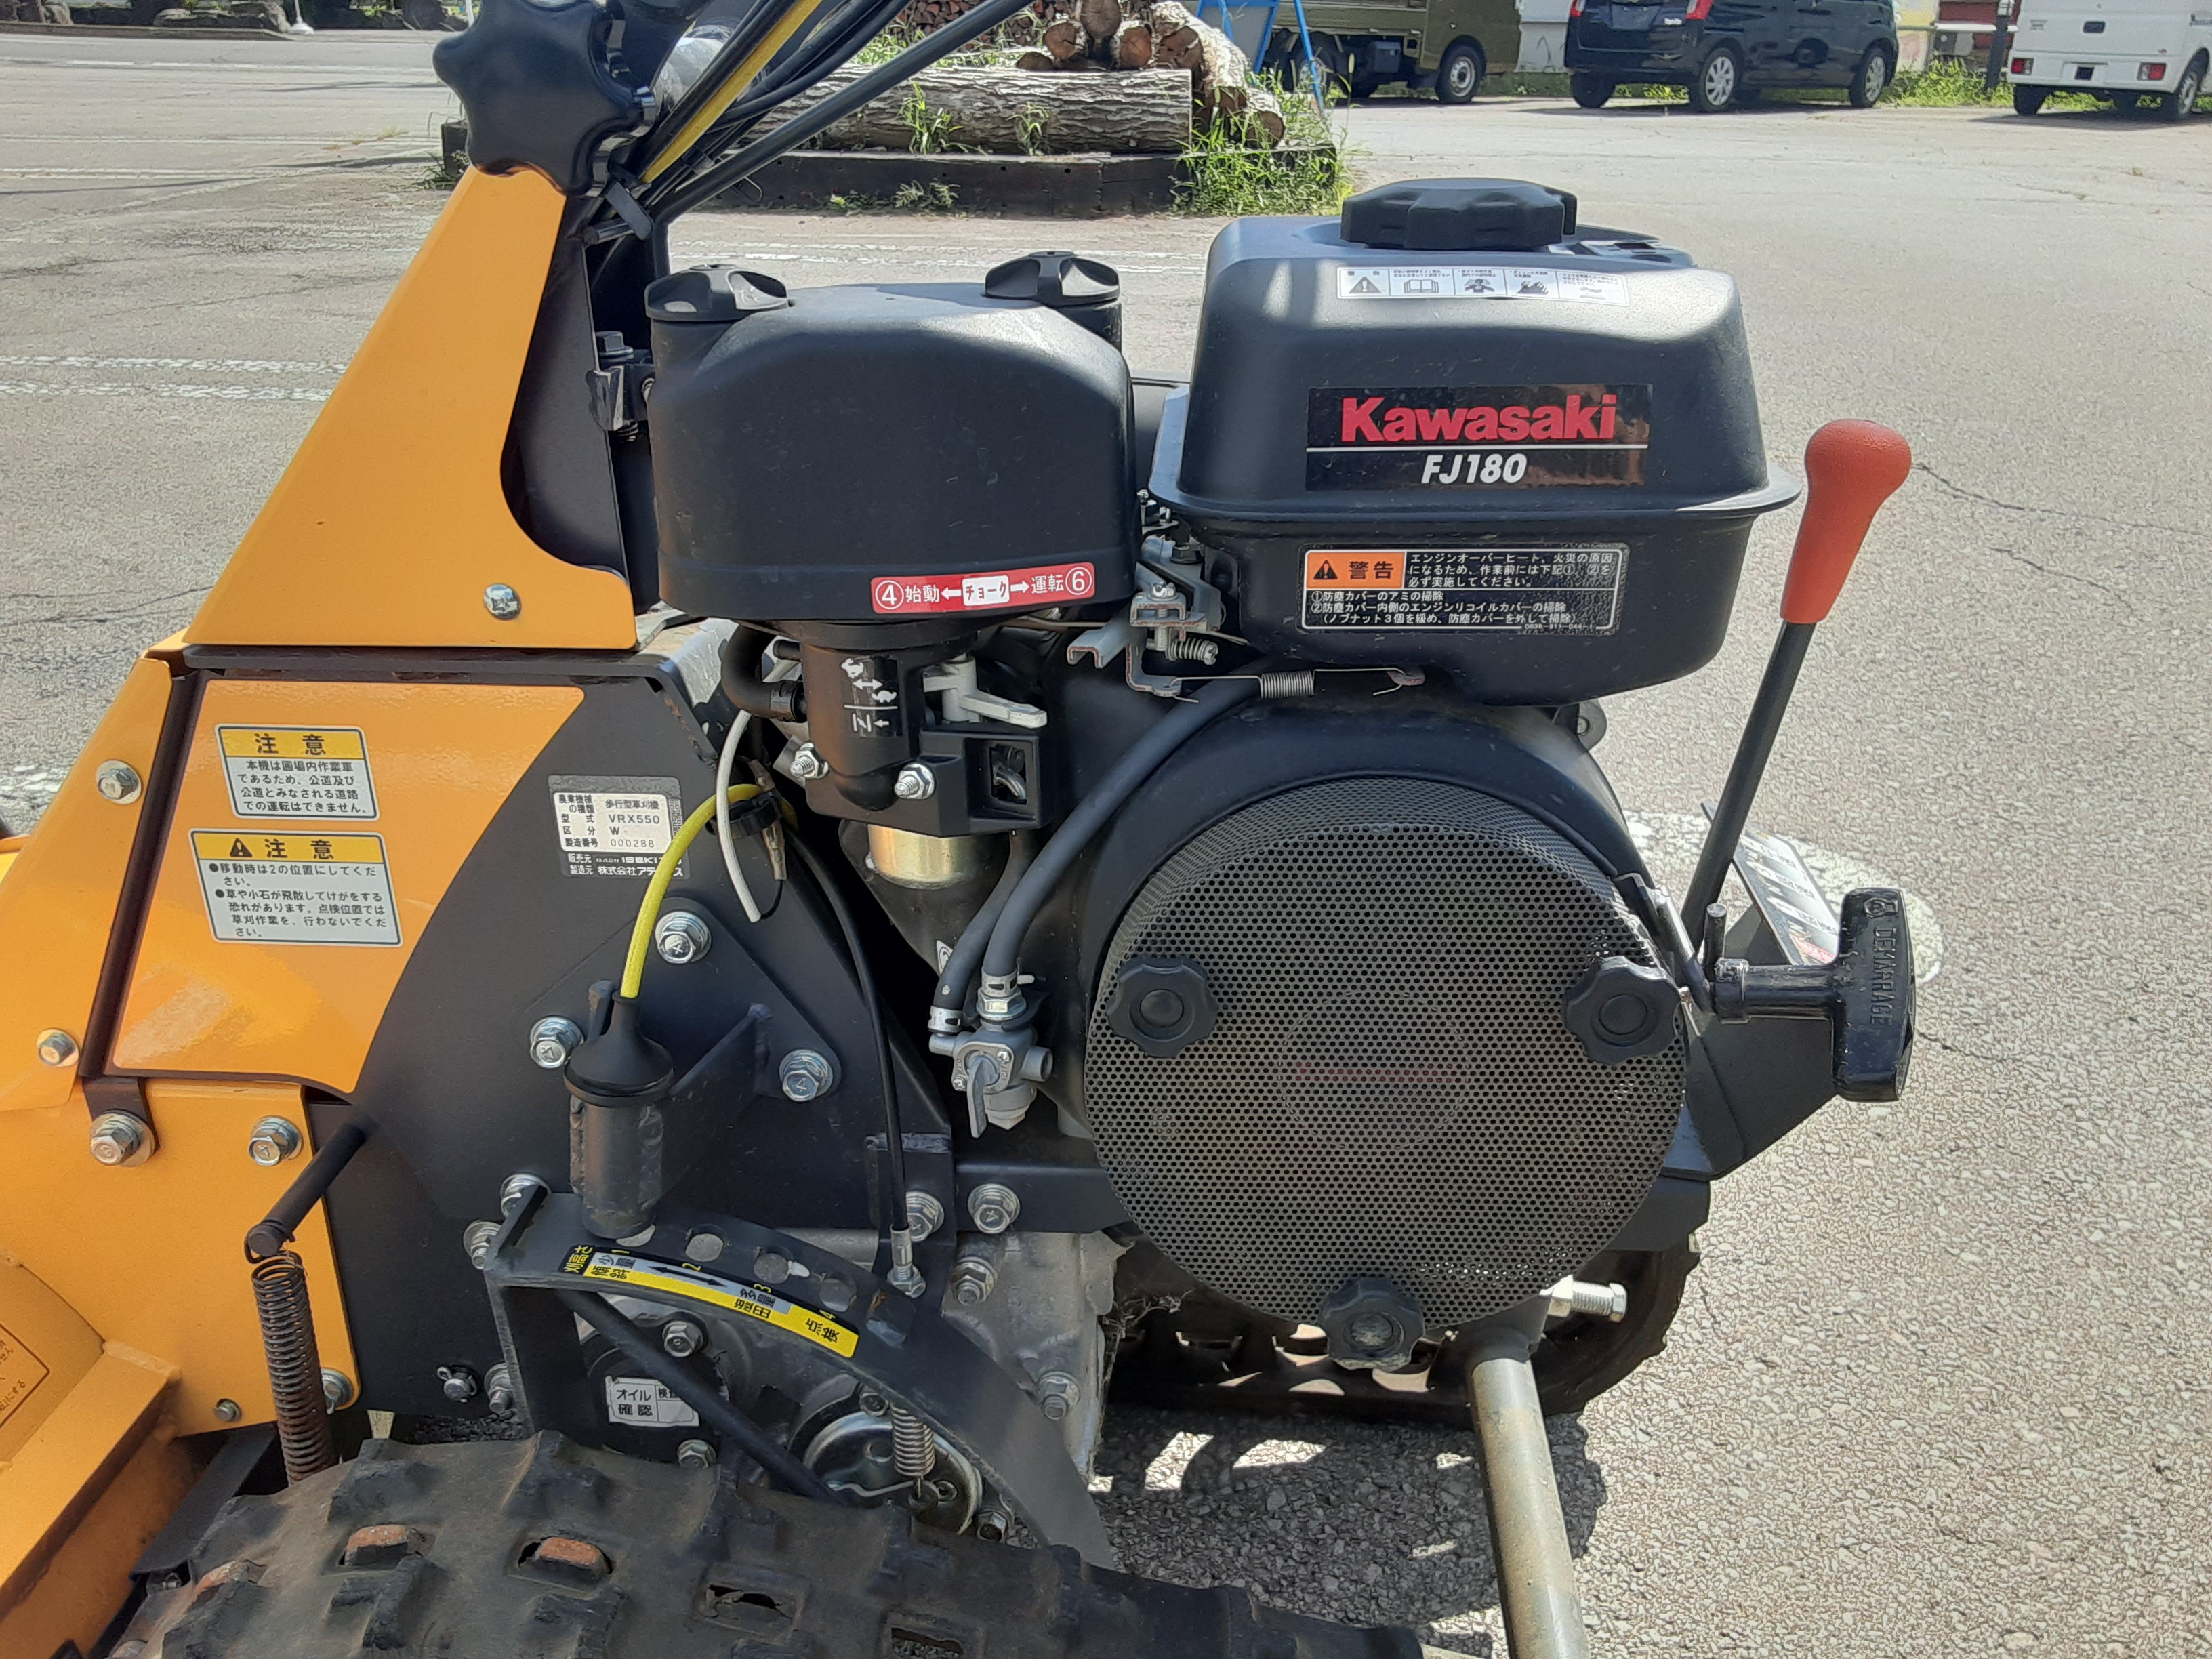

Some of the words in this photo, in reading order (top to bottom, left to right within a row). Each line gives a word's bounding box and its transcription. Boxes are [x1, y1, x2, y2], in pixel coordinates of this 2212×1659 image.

[1340, 394, 1618, 442] Kawasaki
[1420, 453, 1527, 485] FJ180
[1348, 561, 1394, 580] 警告
[1408, 577, 1532, 588] 必ず実施してください。
[966, 581, 1007, 601] チョーク
[254, 733, 327, 756] 注意
[241, 787, 359, 800] 公道とみなされる道路
[609, 815, 660, 824] VRX550
[609, 827, 620, 836] W
[264, 838, 334, 859] 注意
[565, 838, 598, 848] 製造番号
[611, 839, 655, 848] 000288
[598, 866, 684, 876] 株式会社アテス
[564, 1245, 594, 1273] 刈高さ
[682, 1262, 702, 1272] 2
[753, 1283, 772, 1294] 3
[819, 1309, 836, 1319] 4
[805, 1318, 840, 1343] 点検
[616, 1389, 651, 1401] オイル
[618, 1404, 653, 1416] 確認
